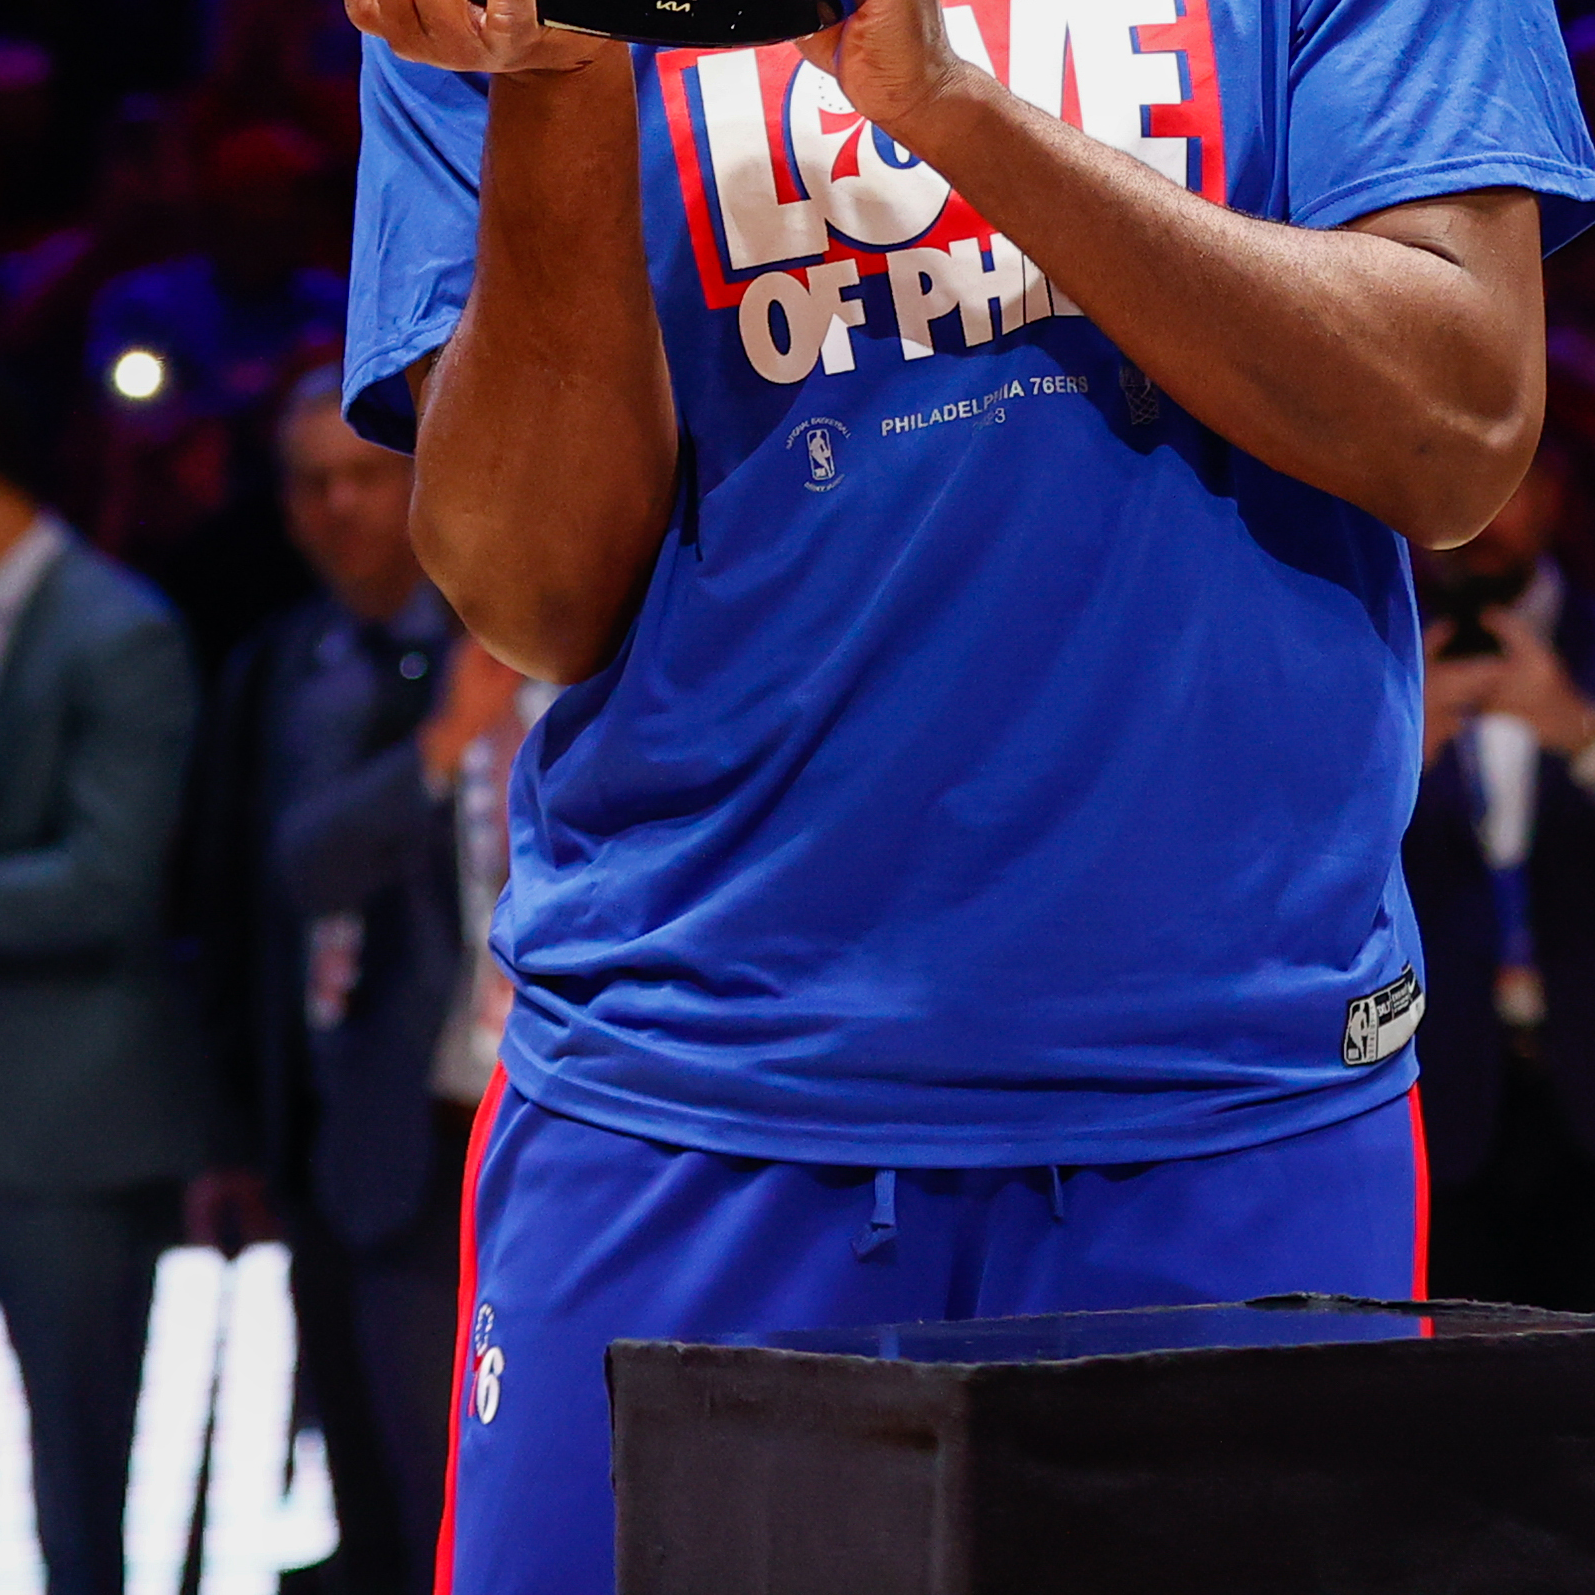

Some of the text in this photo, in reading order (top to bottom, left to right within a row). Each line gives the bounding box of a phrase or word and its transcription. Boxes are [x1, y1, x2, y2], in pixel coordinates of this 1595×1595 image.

[738, 232, 1087, 384] OF PHI
[881, 376, 1089, 436] PHILADELPHIA 76ERS
